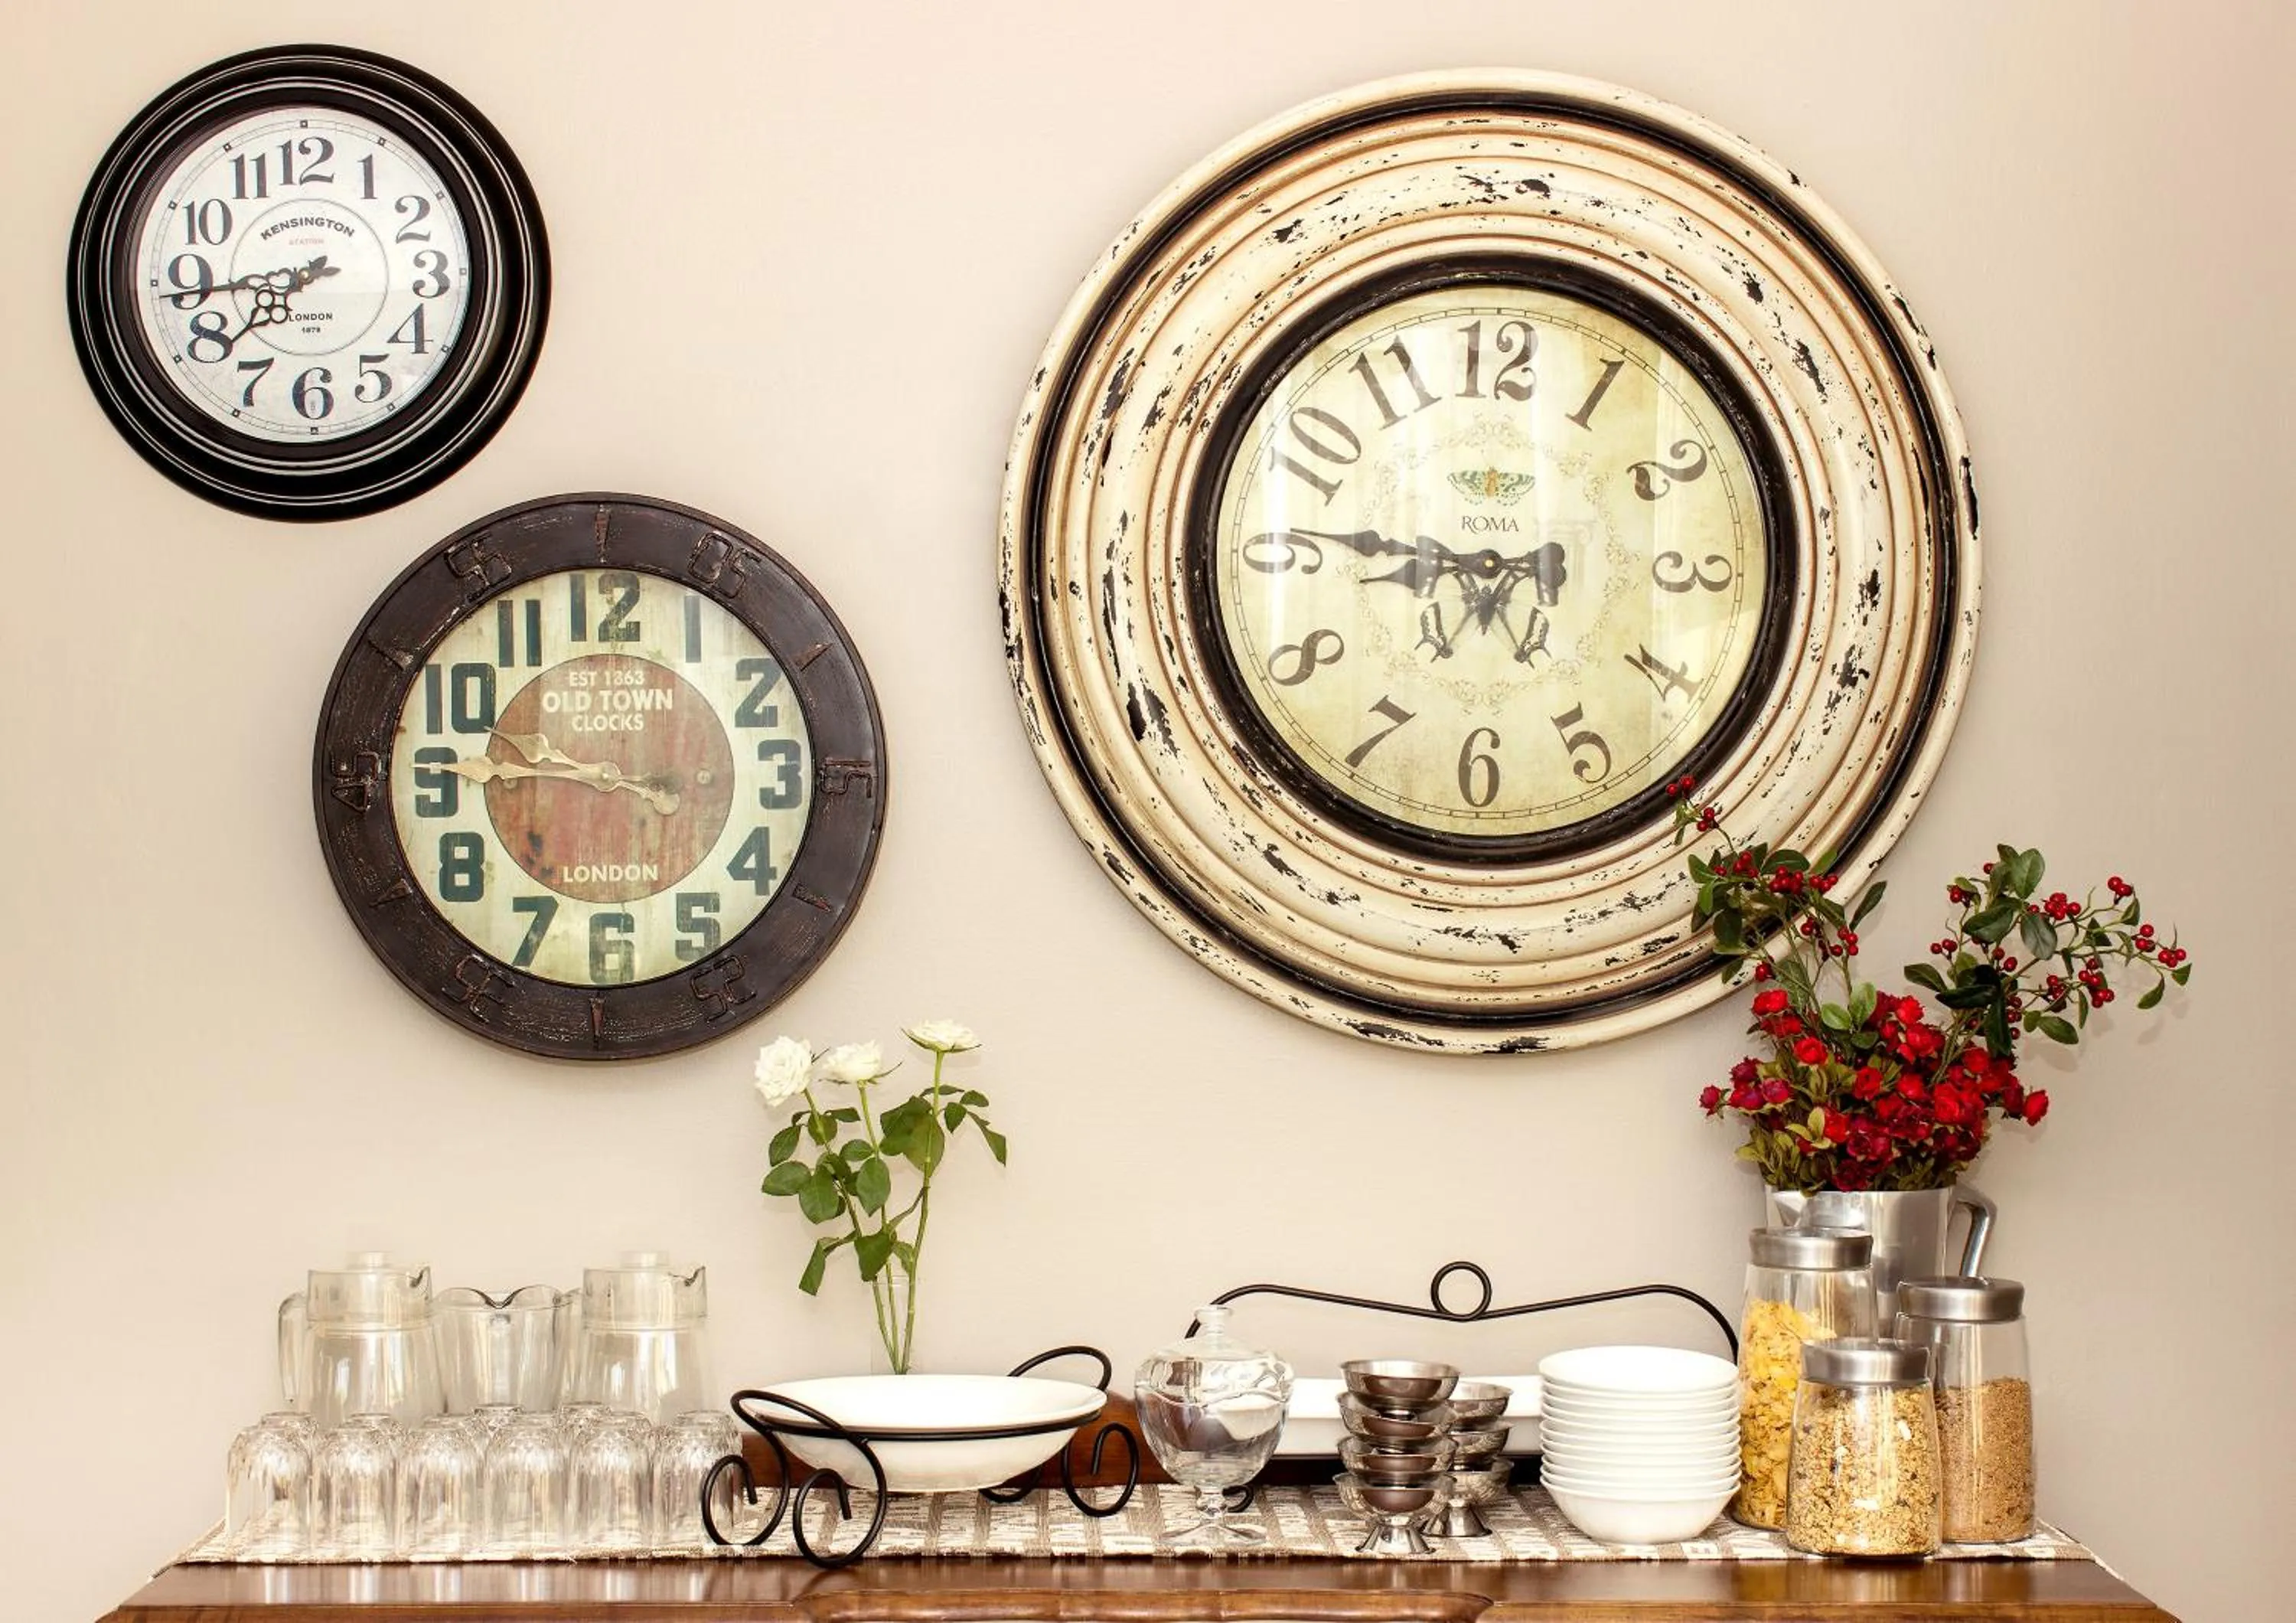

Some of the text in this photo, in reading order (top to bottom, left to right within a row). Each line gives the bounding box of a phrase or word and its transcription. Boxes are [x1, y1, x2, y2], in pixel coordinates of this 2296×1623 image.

[232, 153, 270, 199] 11
[276, 136, 334, 185] 12
[358, 154, 378, 199] 1
[183, 198, 233, 245] 10
[260, 217, 355, 240] KENSINGTON
[394, 195, 431, 243] 2
[168, 253, 213, 309] 9
[413, 250, 450, 299] 3
[187, 311, 233, 363] 8
[289, 312, 333, 322] LONDON
[386, 302, 434, 354] 4
[237, 357, 275, 407] 7
[354, 353, 393, 403] 5
[1348, 335, 1442, 430] 11
[1455, 320, 1539, 402] 12
[292, 367, 334, 420] 6
[1565, 357, 1626, 432] 1
[1268, 407, 1362, 507] 10
[1626, 439, 1708, 501] 2
[1242, 531, 1323, 575] 9
[1461, 515, 1519, 534] ROMA
[1652, 550, 1733, 593] 3
[497, 599, 542, 667] 11
[570, 573, 641, 642] 12
[683, 594, 702, 664] 1
[569, 671, 644, 687] EST 1863
[1268, 629, 1345, 686] 8
[1624, 643, 1704, 704] 4
[425, 663, 496, 734] 10
[542, 689, 673, 713] OLD TOWN
[735, 658, 783, 728] 2
[572, 714, 644, 731] CLOCKS
[1345, 694, 1417, 768] 7
[1550, 701, 1613, 784] 5
[415, 747, 458, 818] 9
[758, 740, 802, 810] 3
[1457, 727, 1501, 808] 6
[439, 831, 484, 903] 8
[563, 864, 659, 883] LONDON
[726, 825, 778, 896] 4
[511, 896, 559, 967] 7
[589, 913, 634, 985] 6
[676, 892, 722, 962] 5
